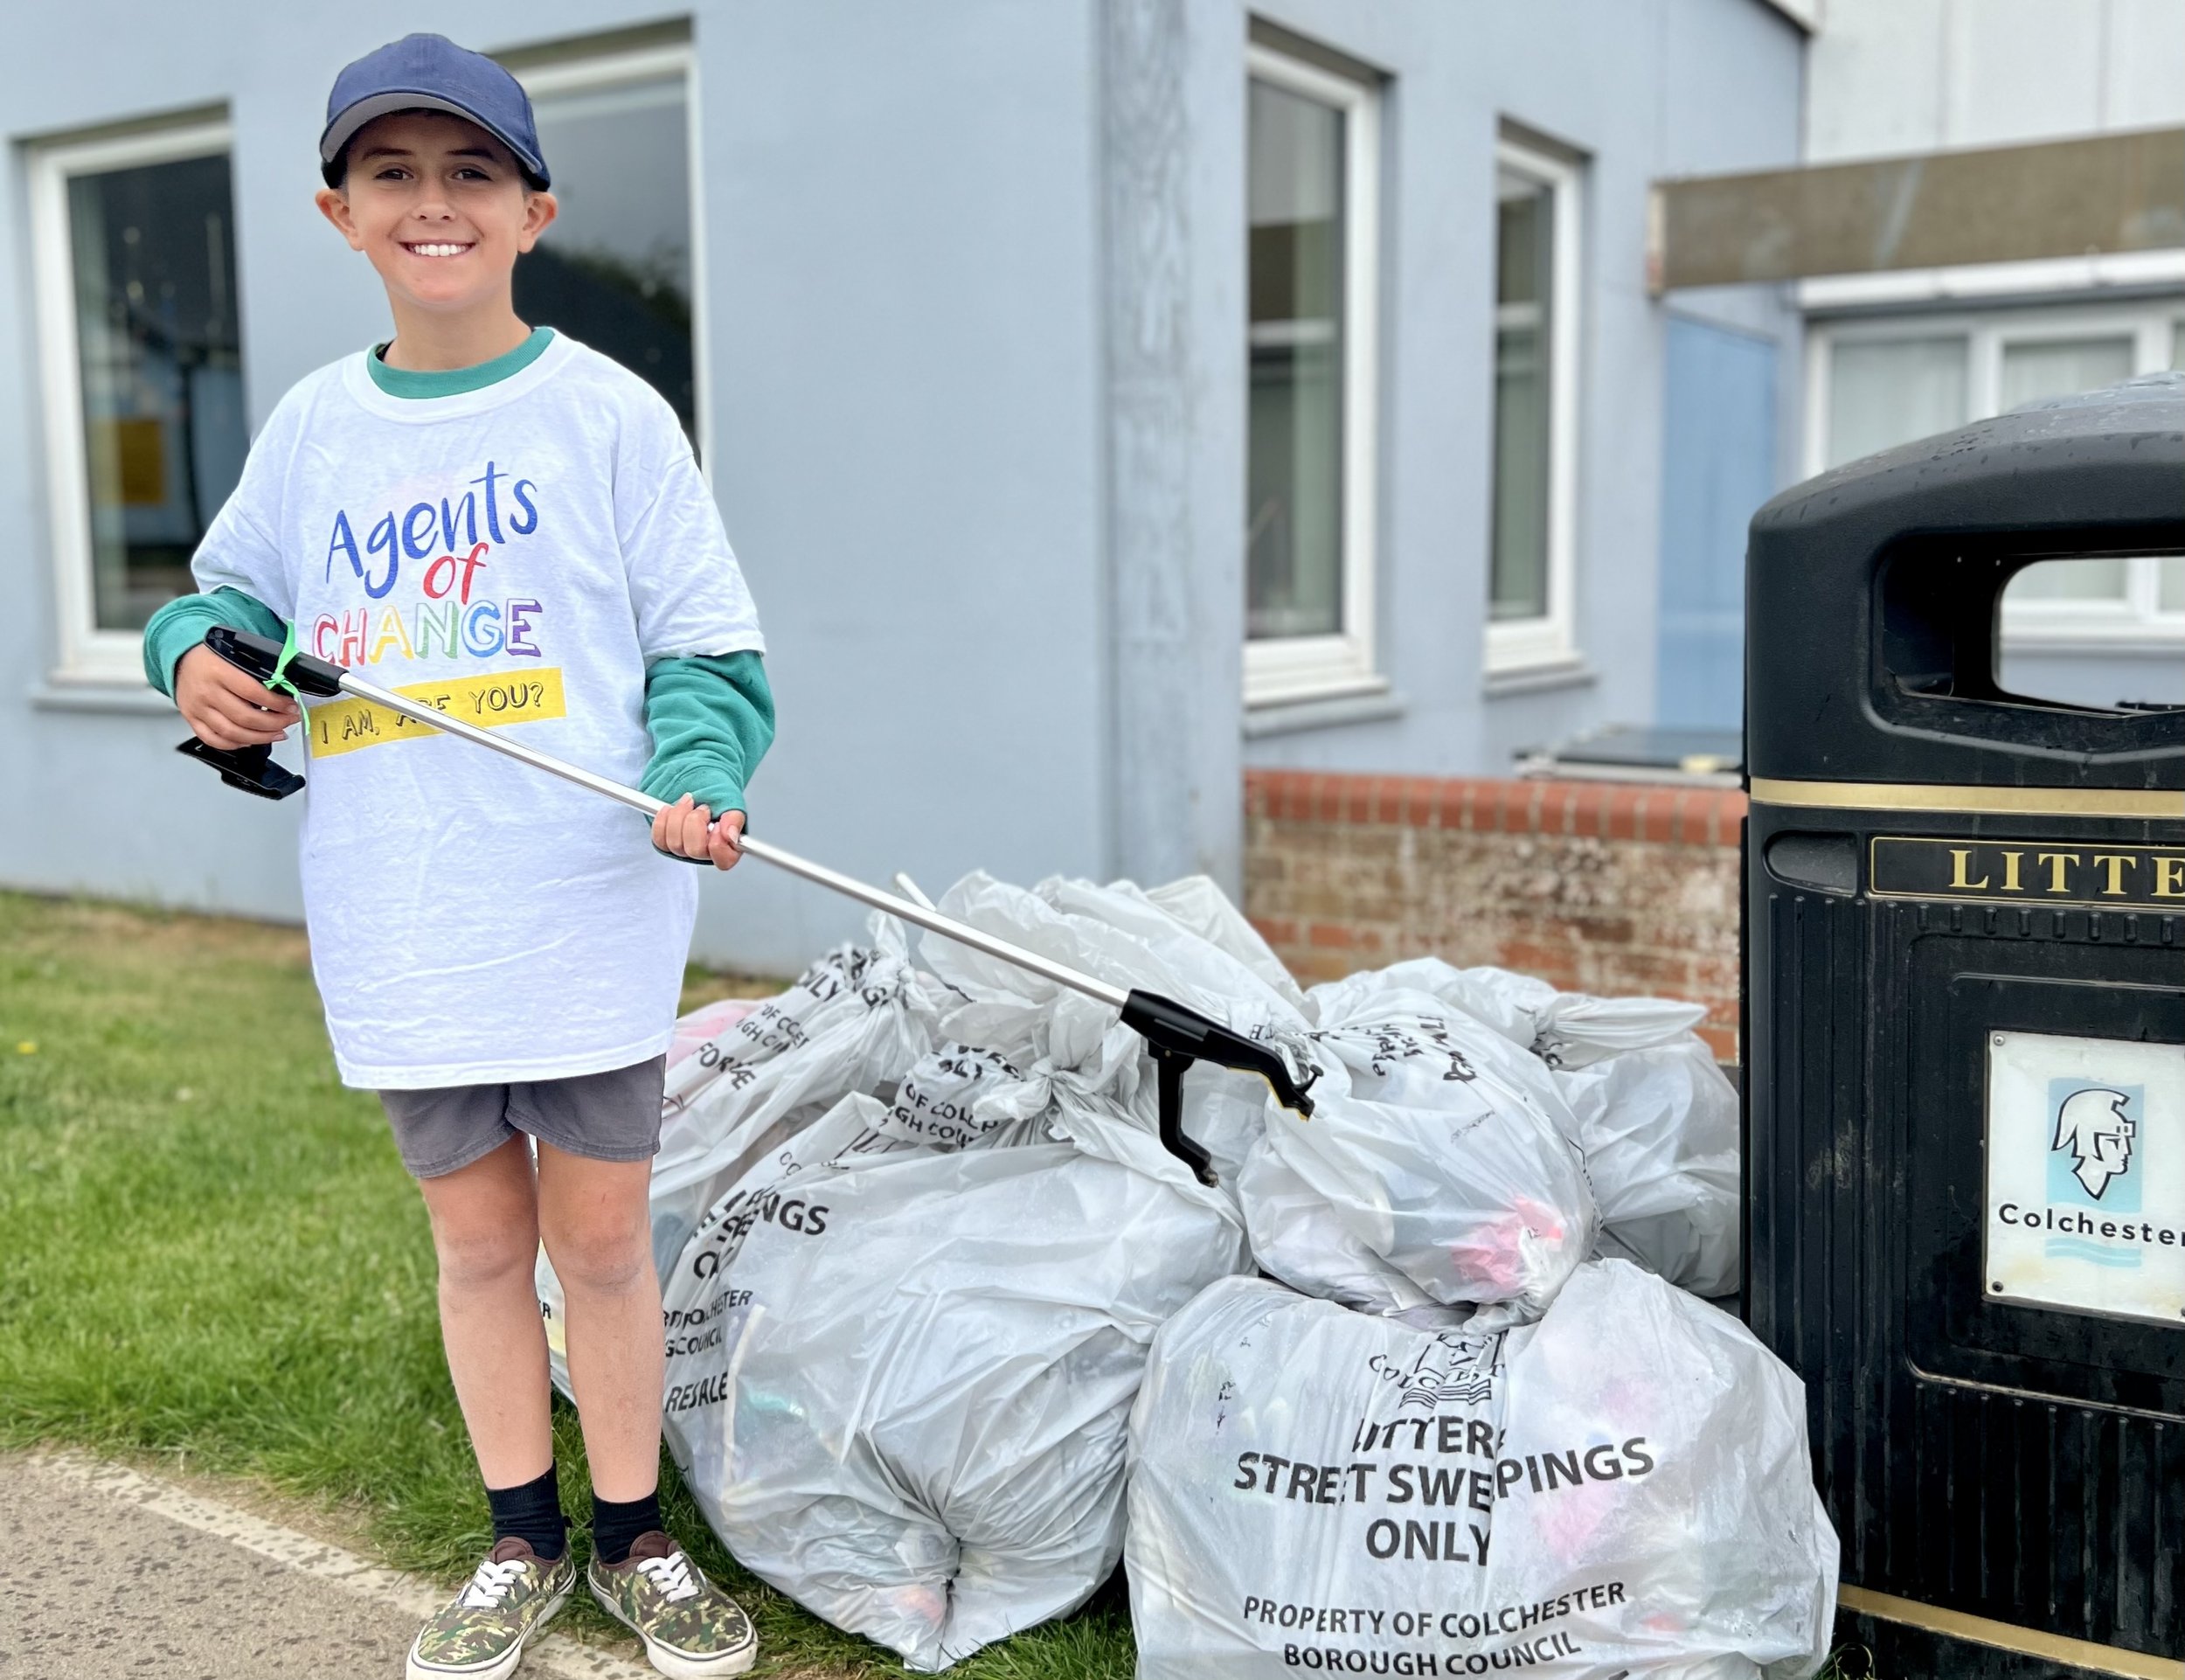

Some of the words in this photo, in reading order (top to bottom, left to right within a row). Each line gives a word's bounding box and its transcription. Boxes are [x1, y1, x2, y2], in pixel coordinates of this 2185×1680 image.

[326, 461, 538, 599] Agents
[423, 542, 488, 605] of
[311, 599, 543, 667] CHANGE
[321, 720, 329, 744] I
[342, 709, 380, 740] AM,
[468, 682, 544, 713] YOU?
[664, 1371, 728, 1413] RESALE
[1366, 1518, 1491, 1566] ONLY
[1244, 1596, 1385, 1635] PROPERTY
[1392, 1611, 1433, 1637] OF
[1440, 1581, 1627, 1639] COLCHESTER
[1284, 1642, 1439, 1677] BOROUGH
[1445, 1631, 1582, 1675] COUNCIL
